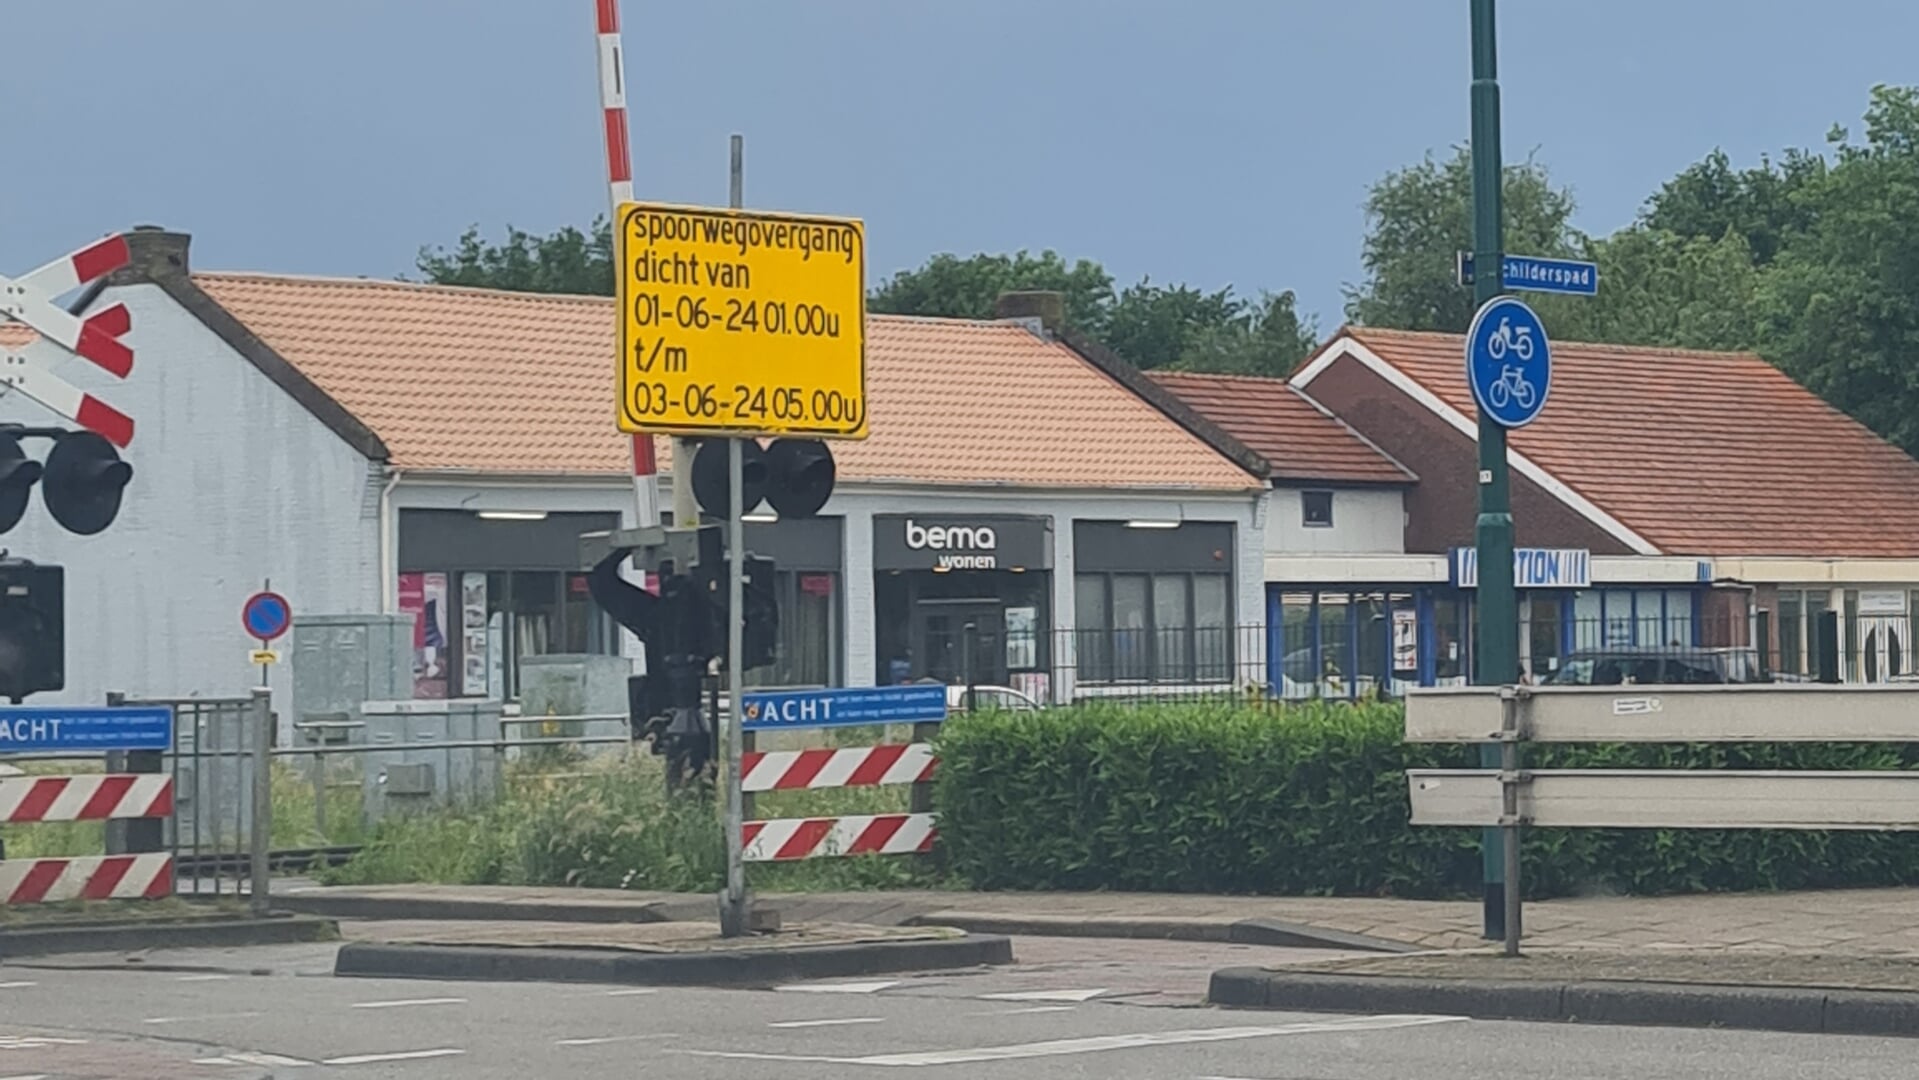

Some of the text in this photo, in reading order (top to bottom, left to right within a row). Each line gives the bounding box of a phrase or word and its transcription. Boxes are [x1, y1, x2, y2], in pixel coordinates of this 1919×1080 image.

[634, 213, 853, 264] spoorwegovergang
[634, 250, 750, 289] dicht van
[634, 293, 840, 337] 01-06-24 01.00u
[634, 337, 687, 373] t/m
[634, 382, 857, 422] 03-06-24 05.00u
[906, 519, 996, 549] bema
[938, 555, 996, 569] wonen
